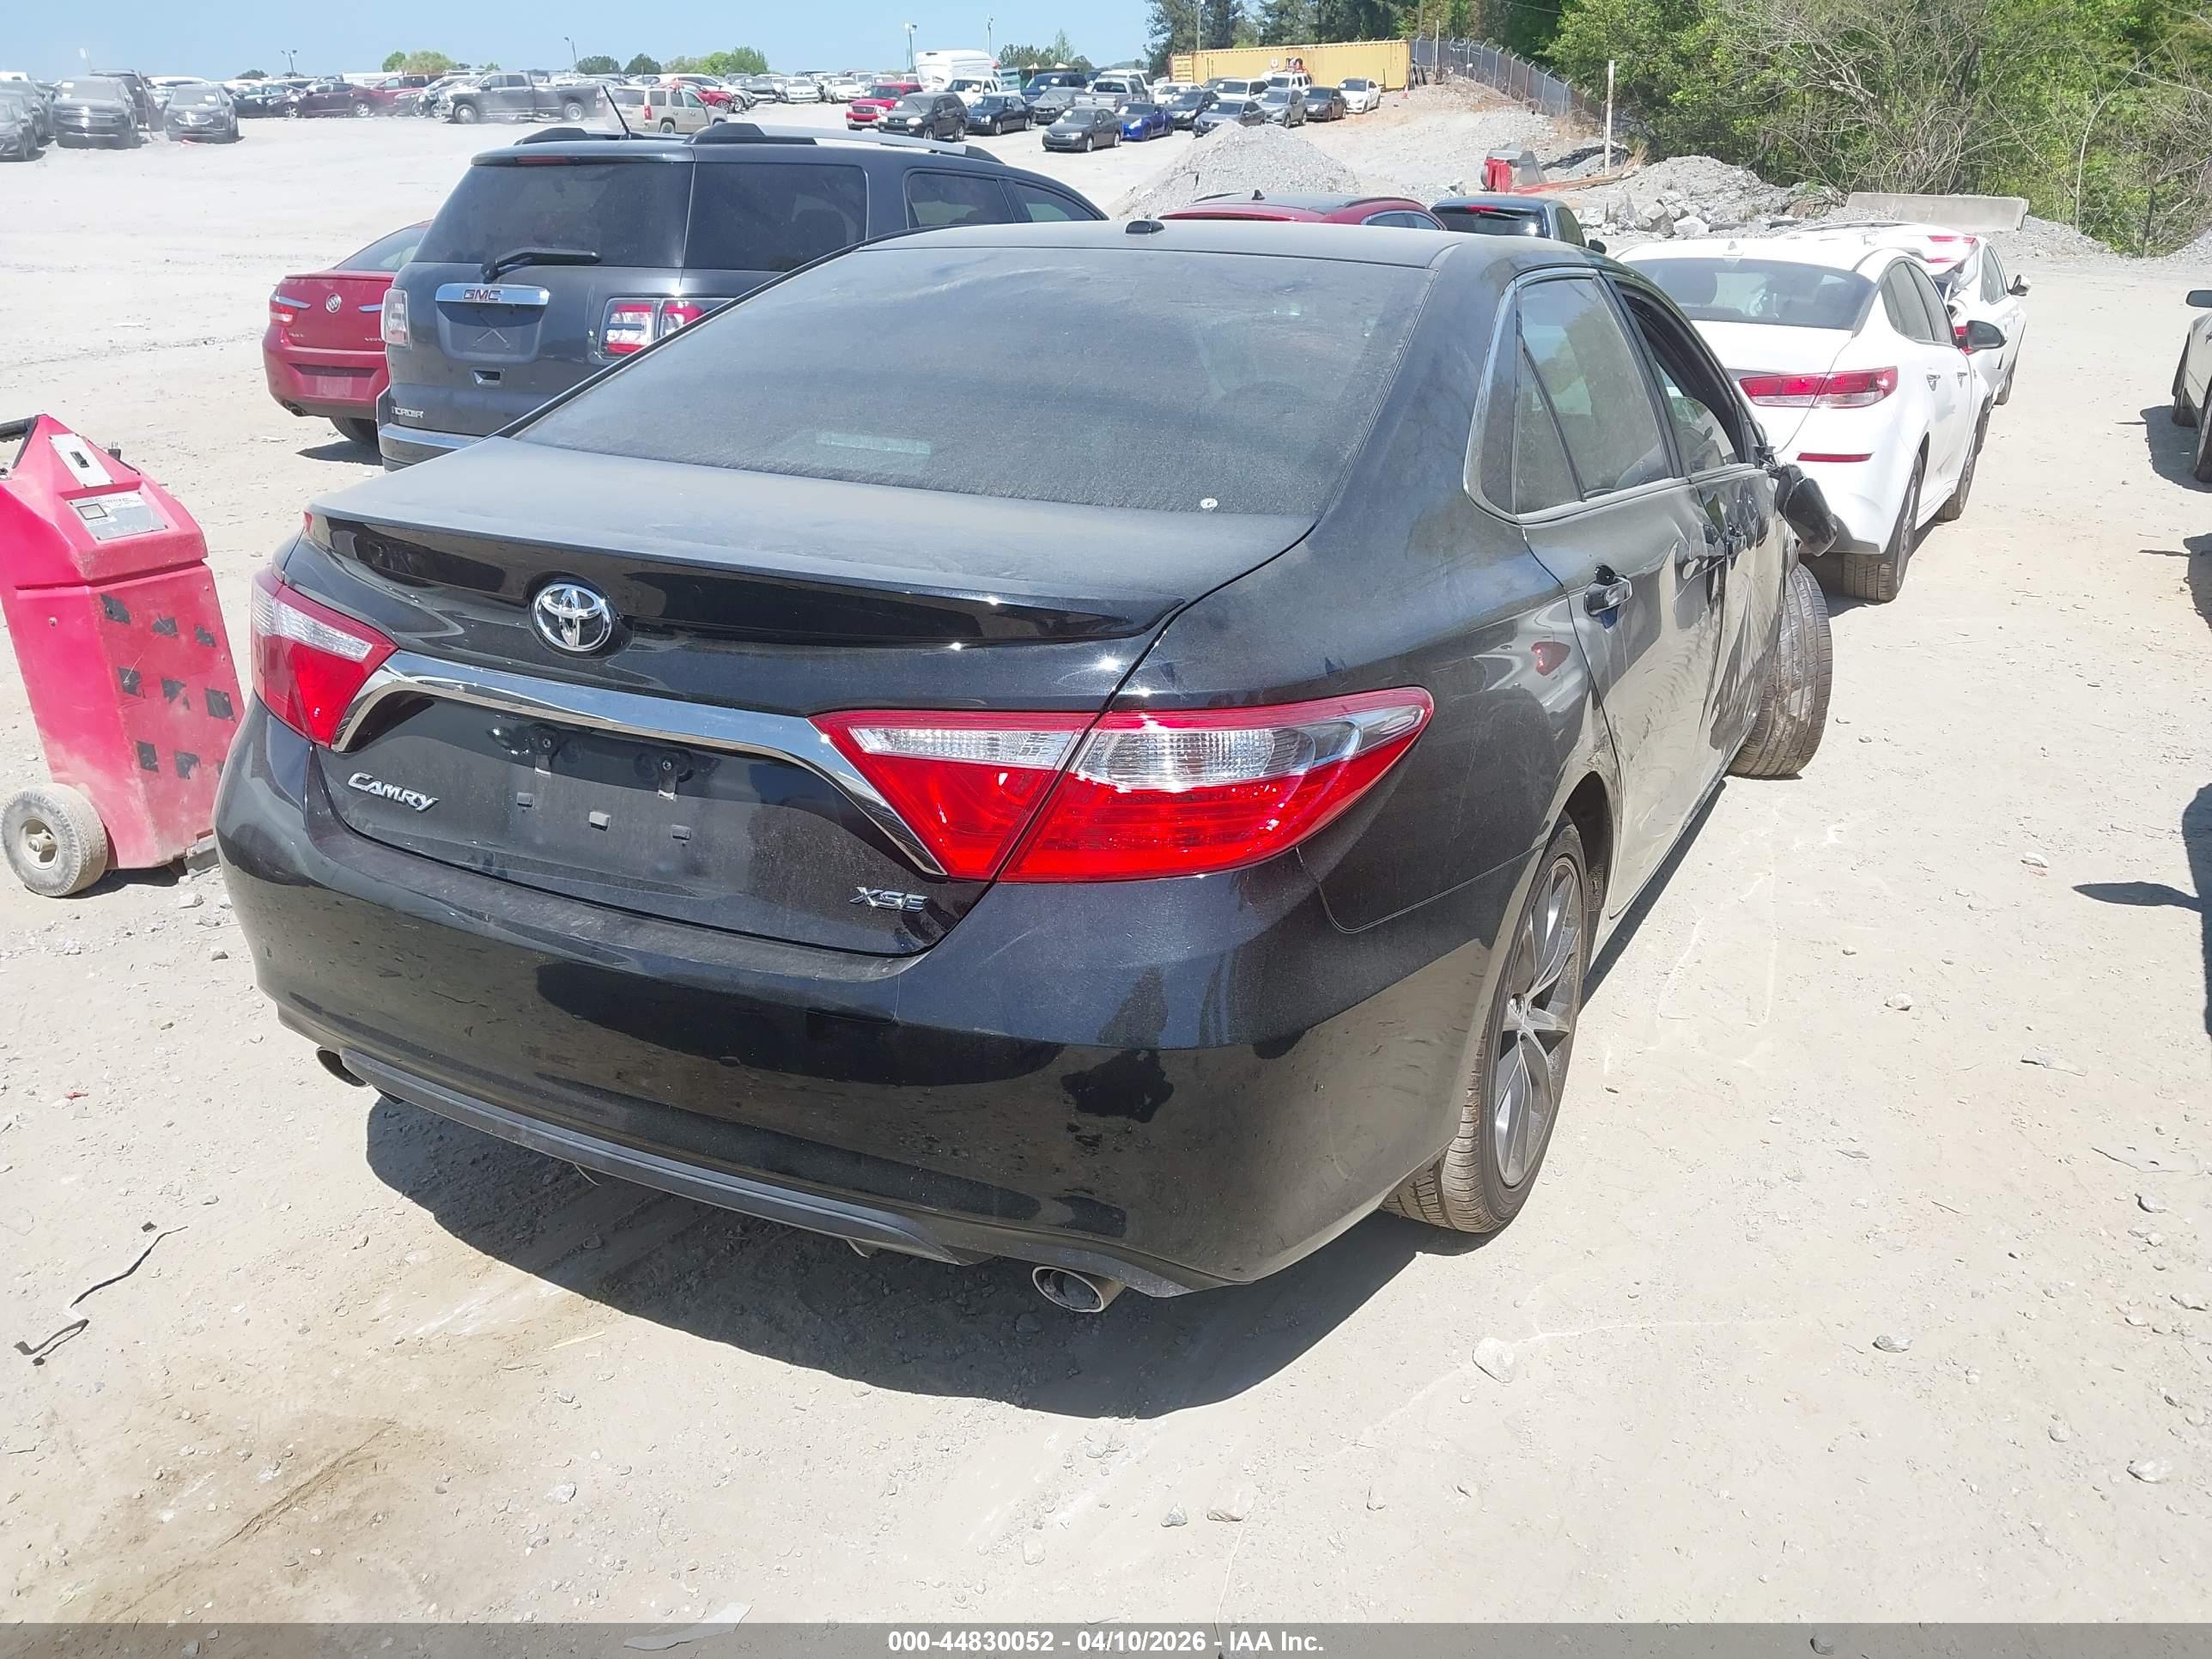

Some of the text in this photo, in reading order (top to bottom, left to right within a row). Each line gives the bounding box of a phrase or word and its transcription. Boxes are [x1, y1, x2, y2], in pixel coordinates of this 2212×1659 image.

[463, 289, 502, 301] GMC
[348, 772, 440, 811] CAMRY
[849, 886, 928, 912] XSE
